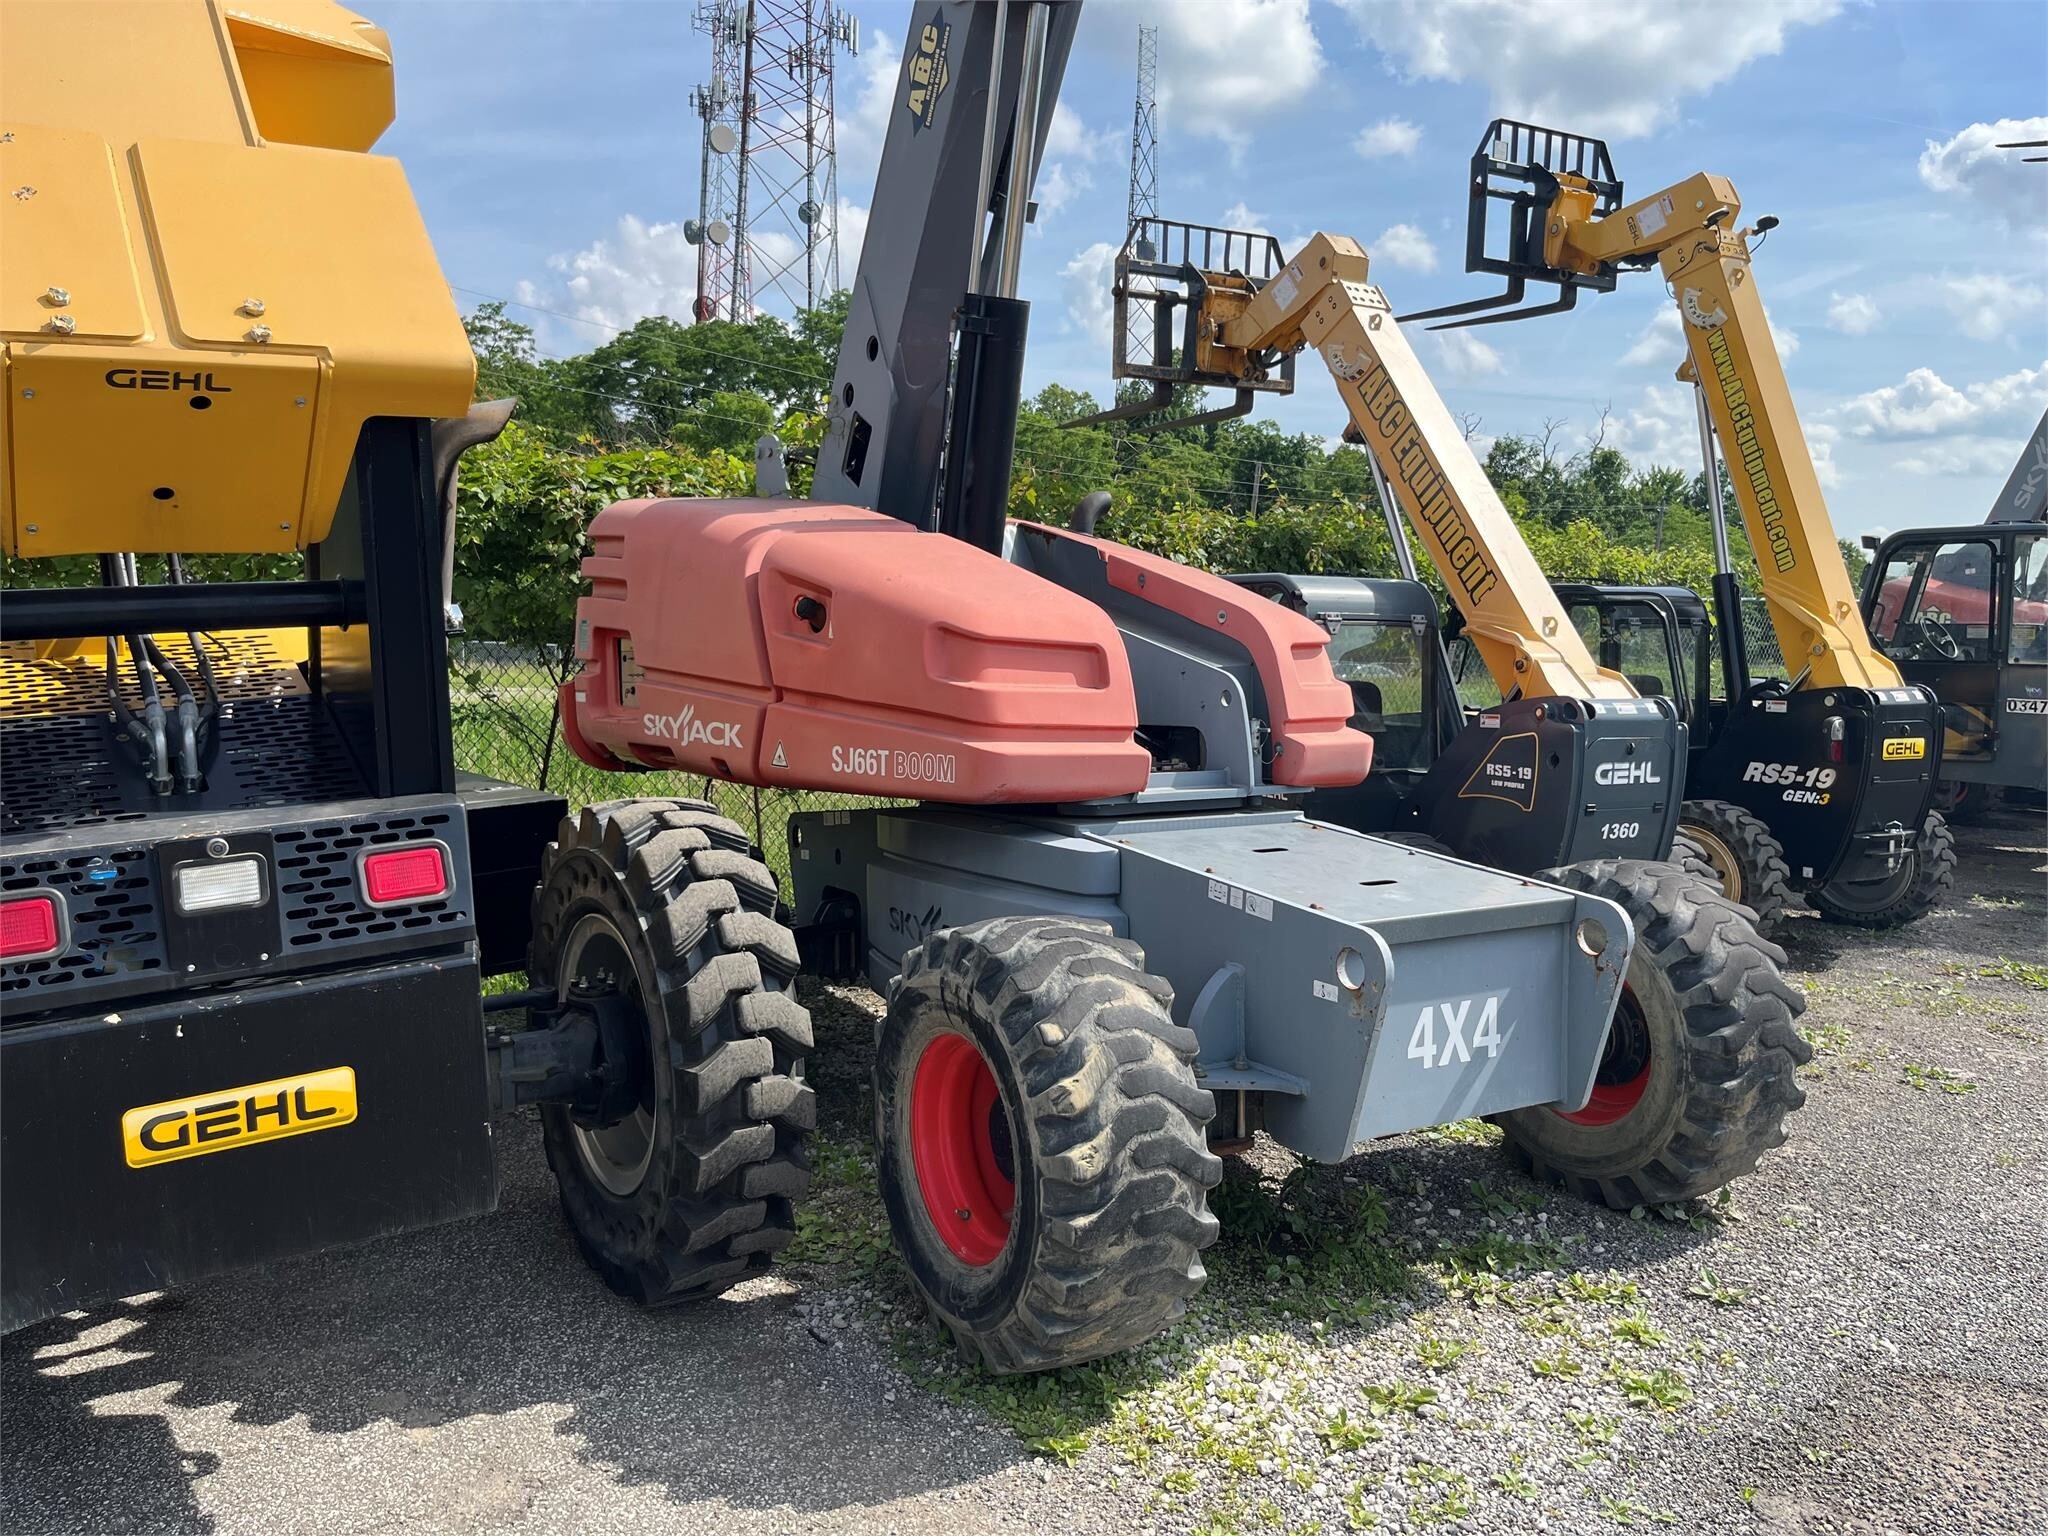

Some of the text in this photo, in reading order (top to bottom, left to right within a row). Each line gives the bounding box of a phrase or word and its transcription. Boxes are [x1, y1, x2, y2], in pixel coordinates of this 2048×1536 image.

[908, 24, 938, 117] ABC
[1627, 216, 1640, 247] GEHL
[105, 369, 232, 392] GEHL
[1358, 364, 1498, 607] ABC Equipment
[643, 703, 744, 749] SKYJACK
[1886, 742, 1920, 756] GEHL
[832, 745, 955, 783] SJ66T BOOM
[1486, 763, 1532, 780] RS5-19
[1595, 761, 1661, 785] GEHL
[1743, 762, 1837, 789] RS5-19
[1782, 789, 1830, 806] GEN:3
[1601, 822, 1640, 839] 1360
[1407, 996, 1501, 1070] 4X4
[140, 1086, 337, 1151] GEHL
